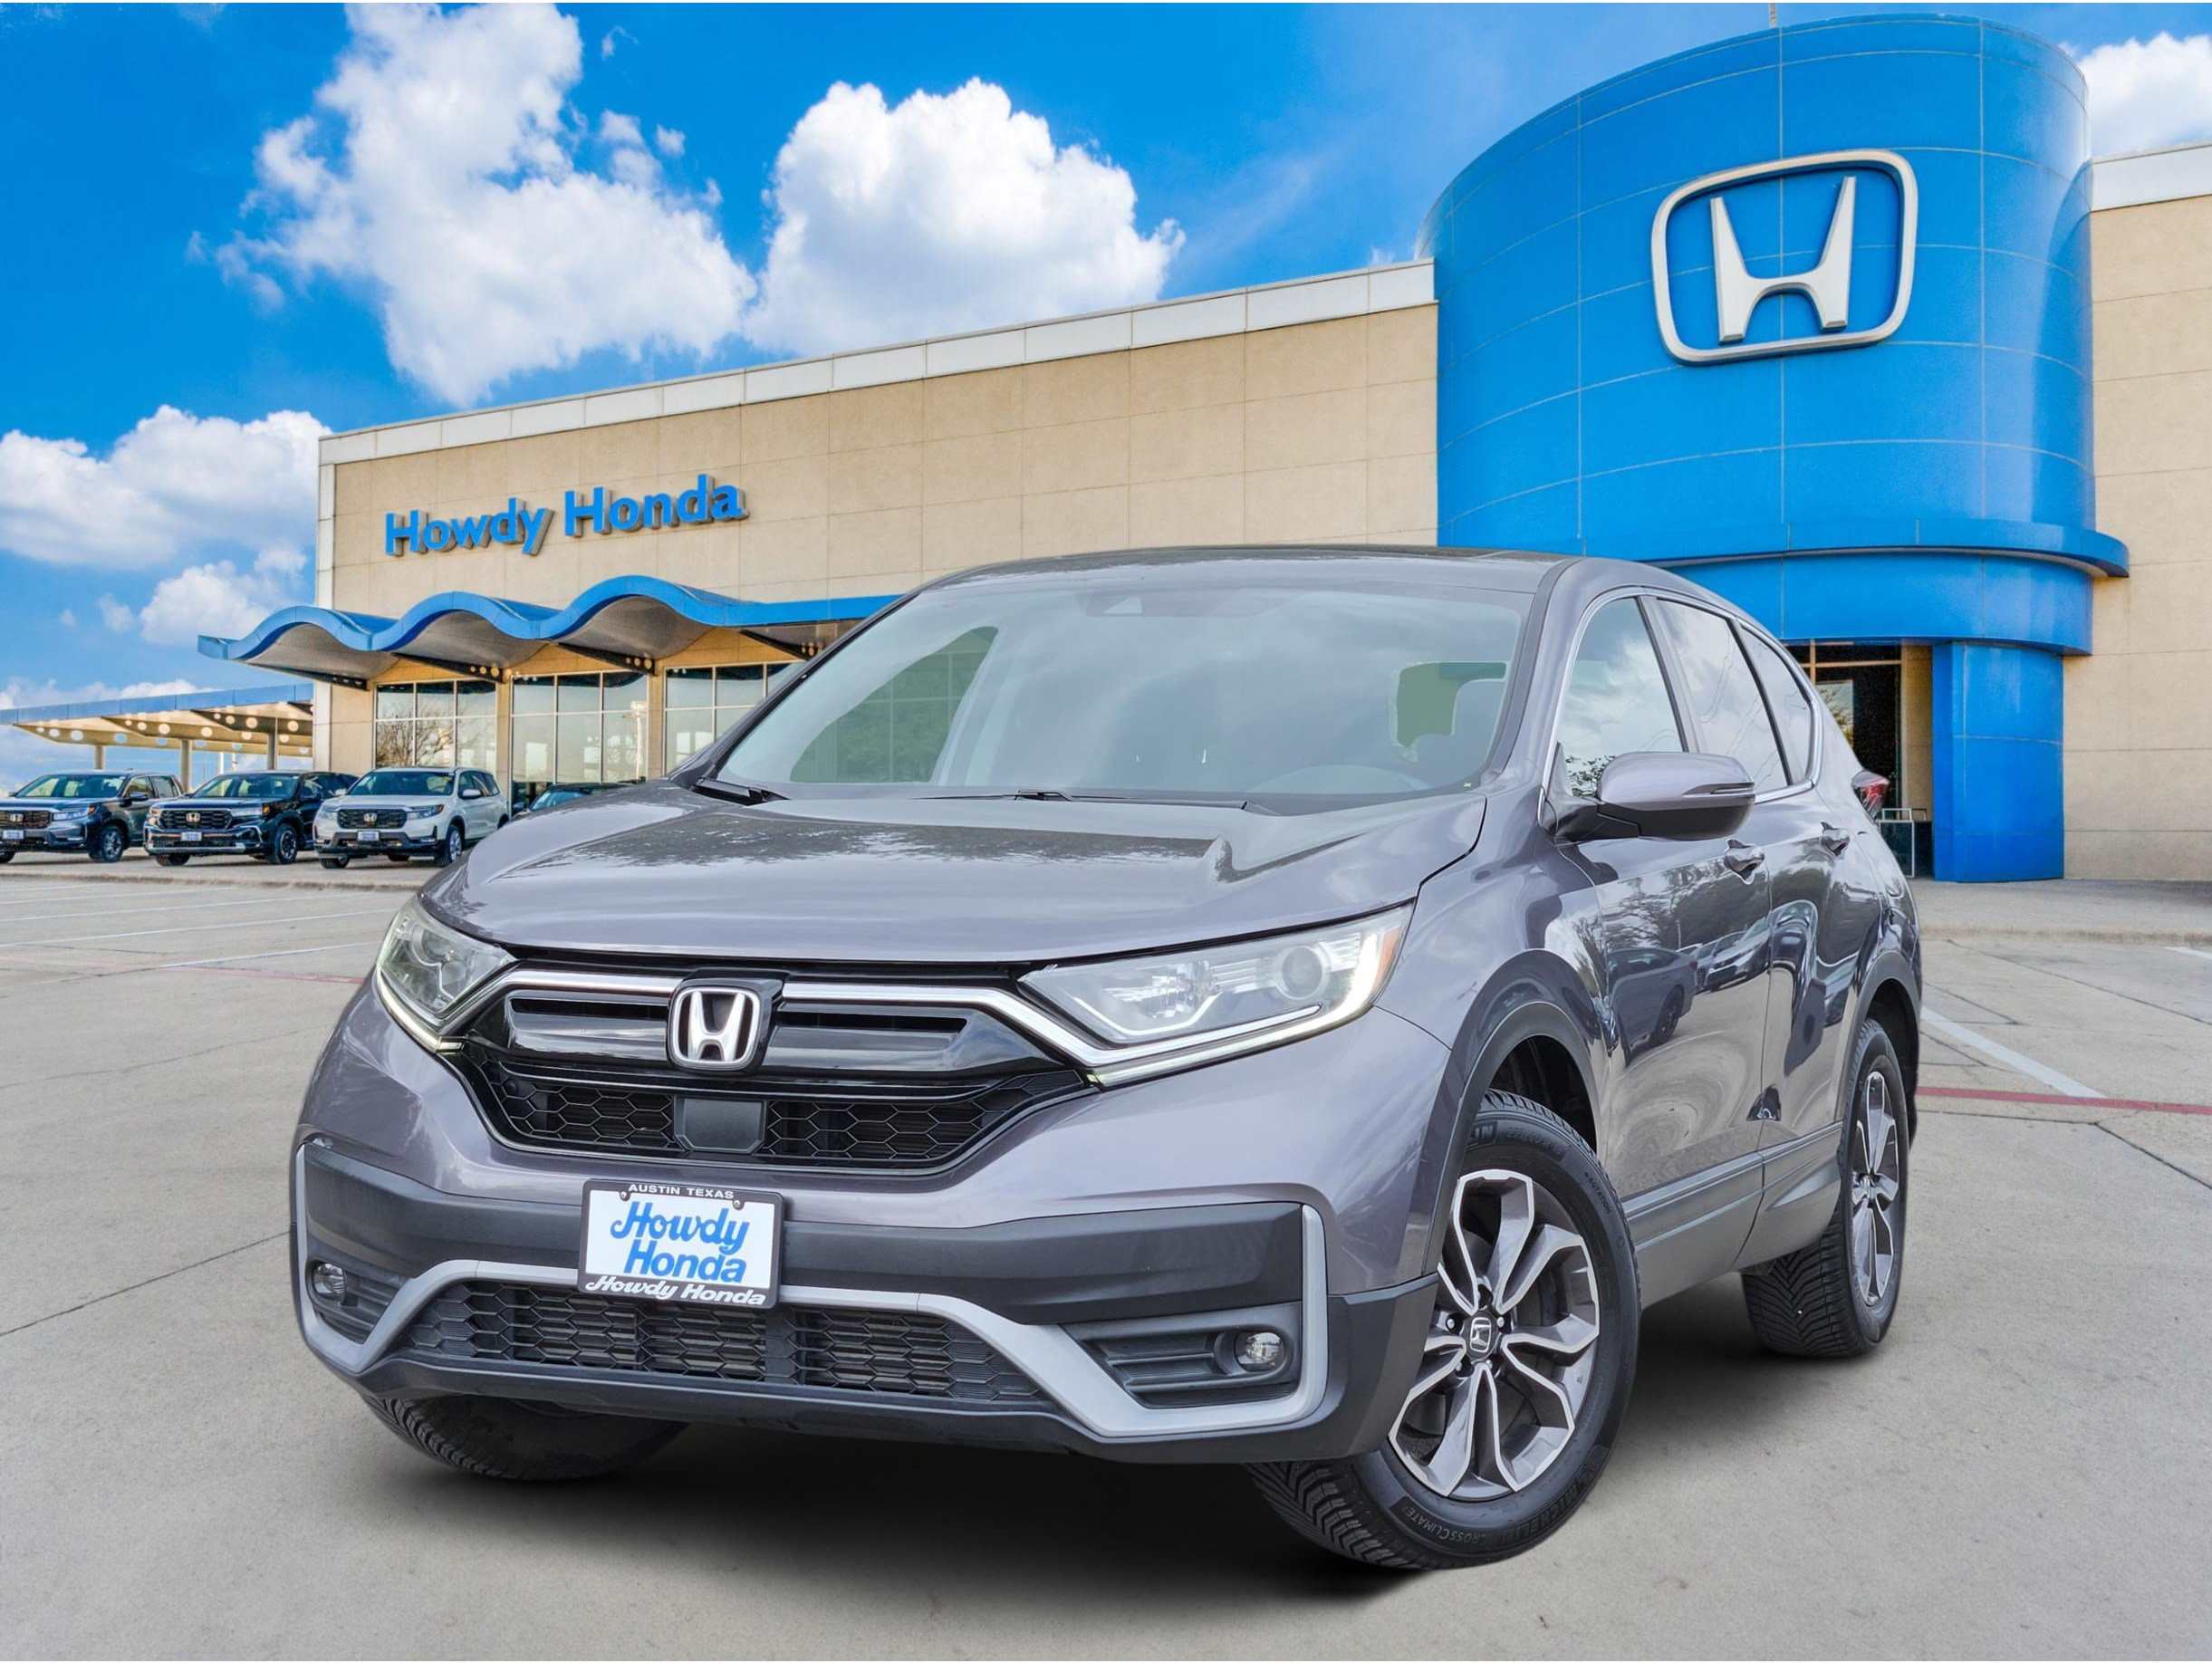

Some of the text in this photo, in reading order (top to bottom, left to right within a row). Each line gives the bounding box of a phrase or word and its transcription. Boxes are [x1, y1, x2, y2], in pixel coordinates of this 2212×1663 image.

[385, 473, 749, 556] Howdy Honda
[628, 1184, 735, 1199] AUSTIN TEXAS
[610, 1201, 750, 1254] Howdy
[623, 1238, 747, 1283] Honda
[585, 1275, 766, 1305] Howdy Honda
